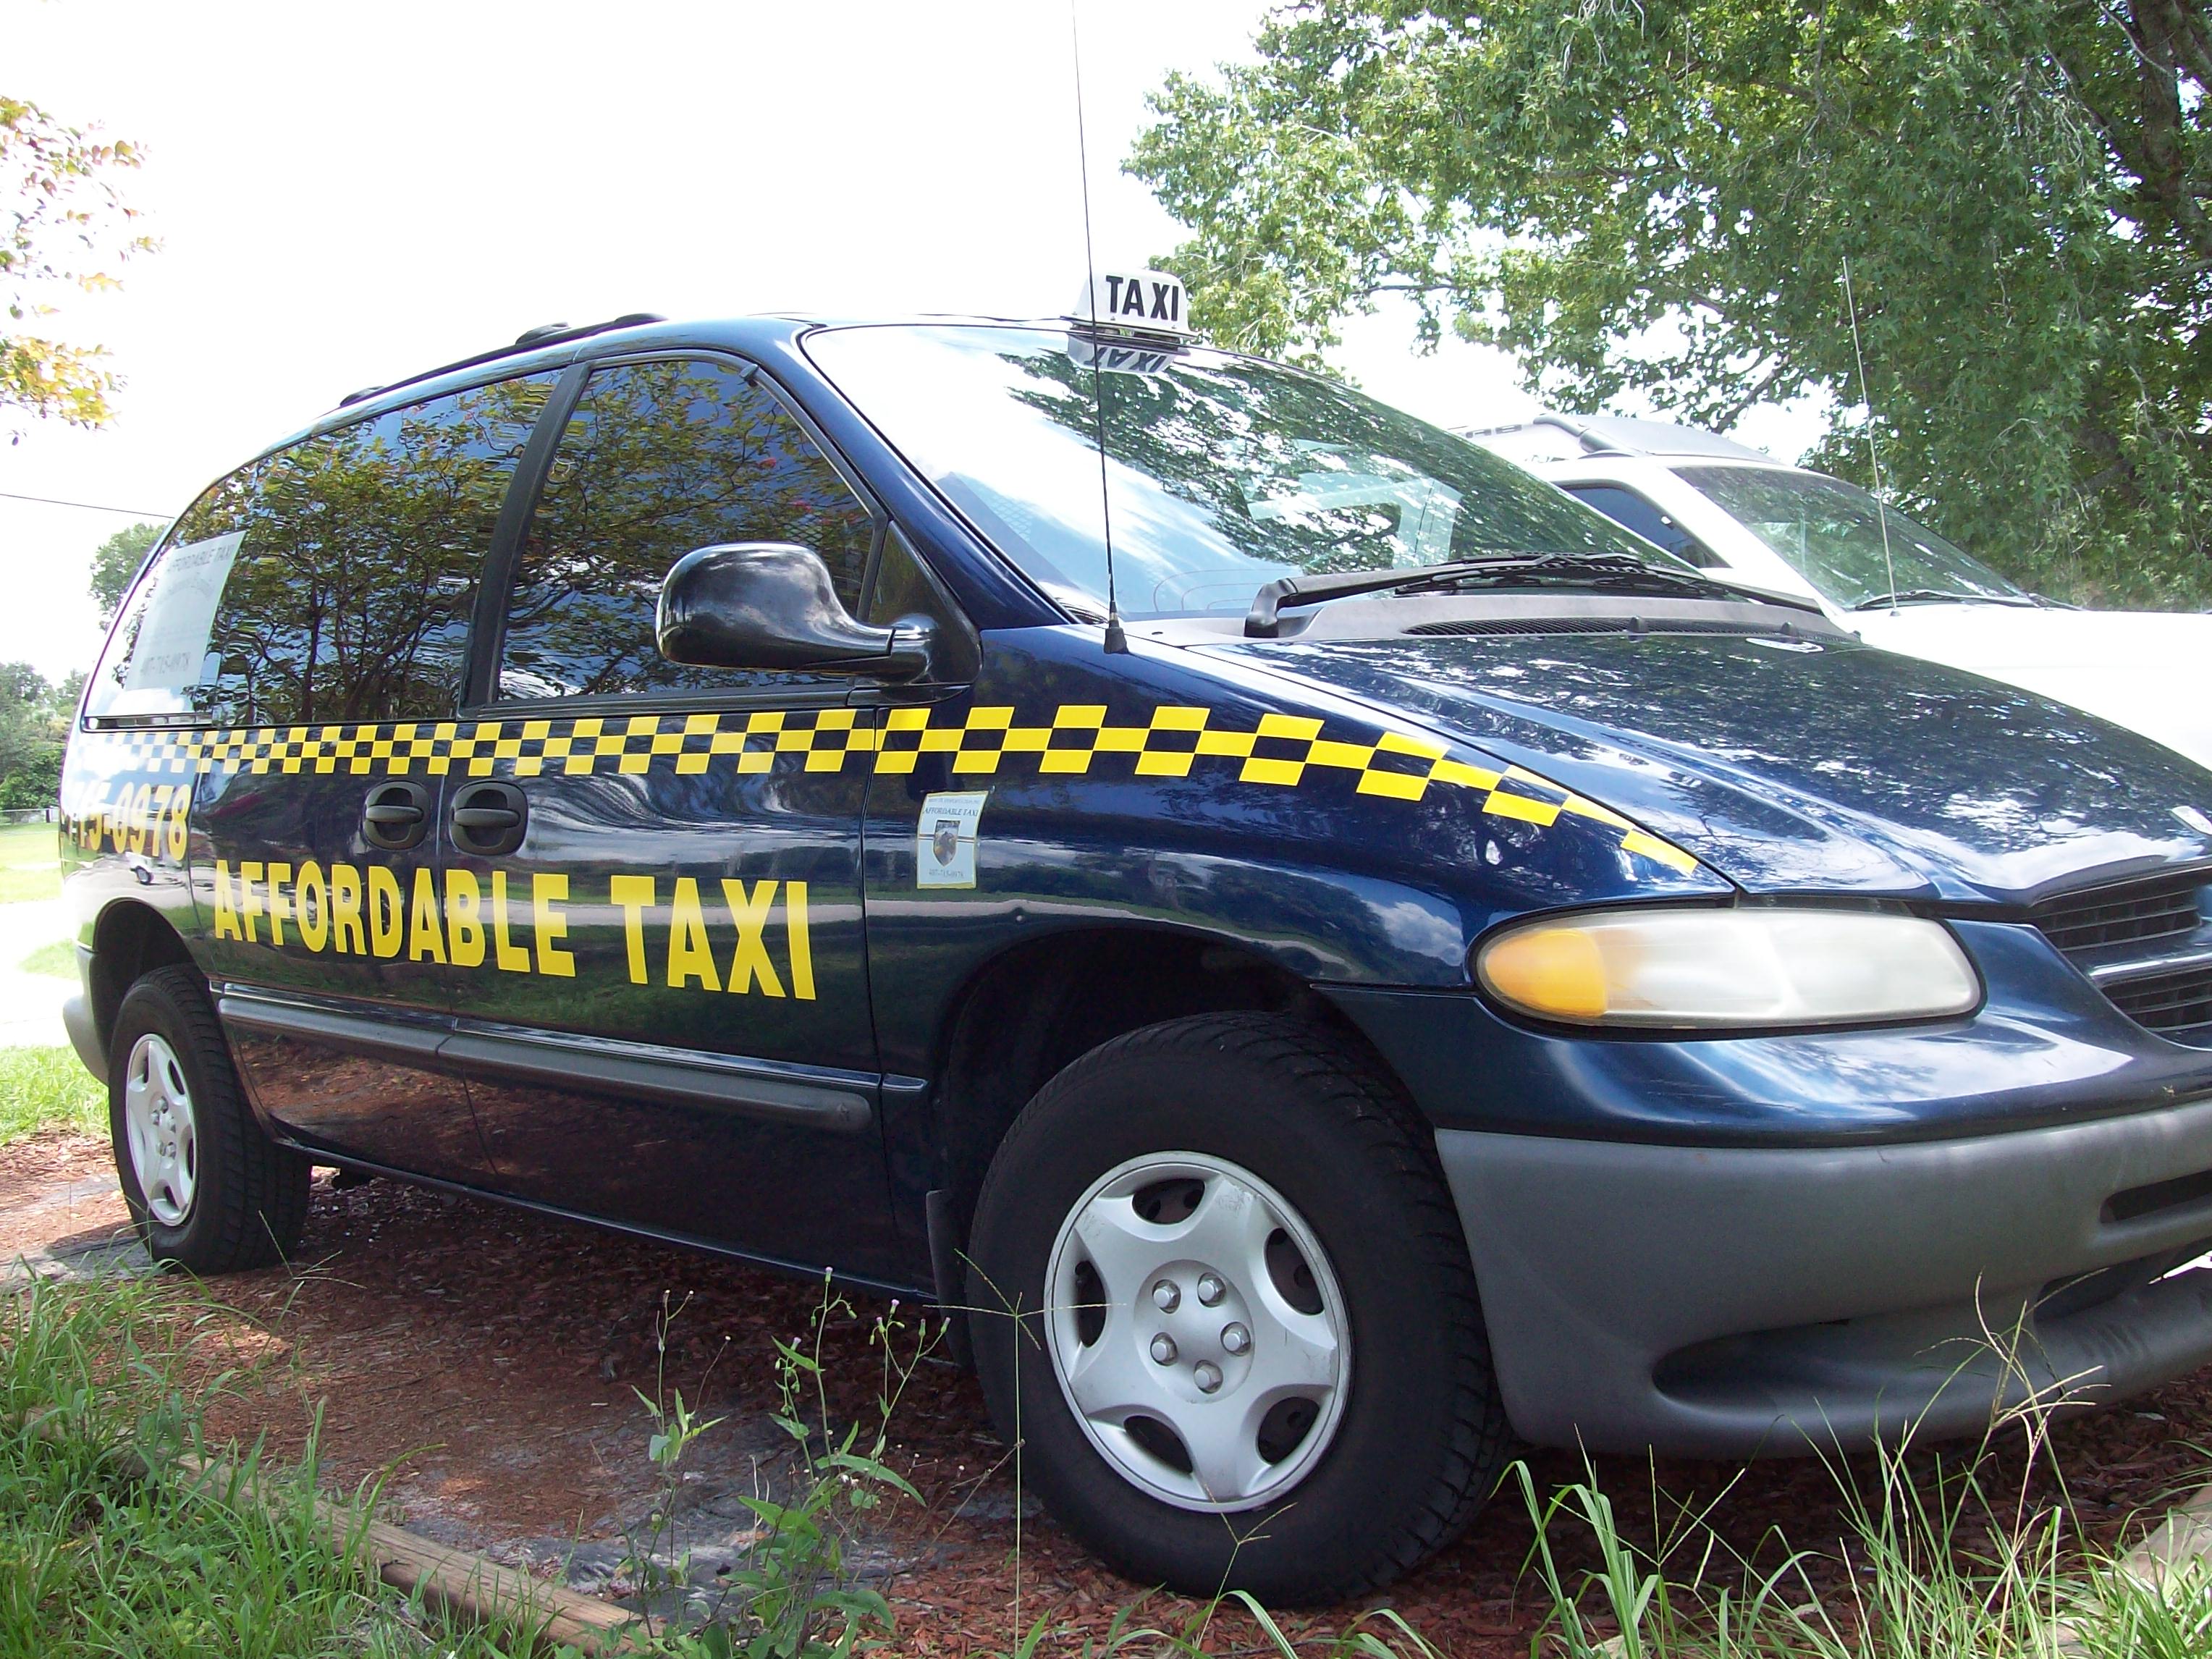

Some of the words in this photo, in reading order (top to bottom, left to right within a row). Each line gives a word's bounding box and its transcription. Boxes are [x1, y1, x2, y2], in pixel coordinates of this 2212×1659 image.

[1106, 275, 1179, 321] TAXI
[214, 859, 576, 978] AFFORDABLE
[609, 874, 816, 1000] TAXI
